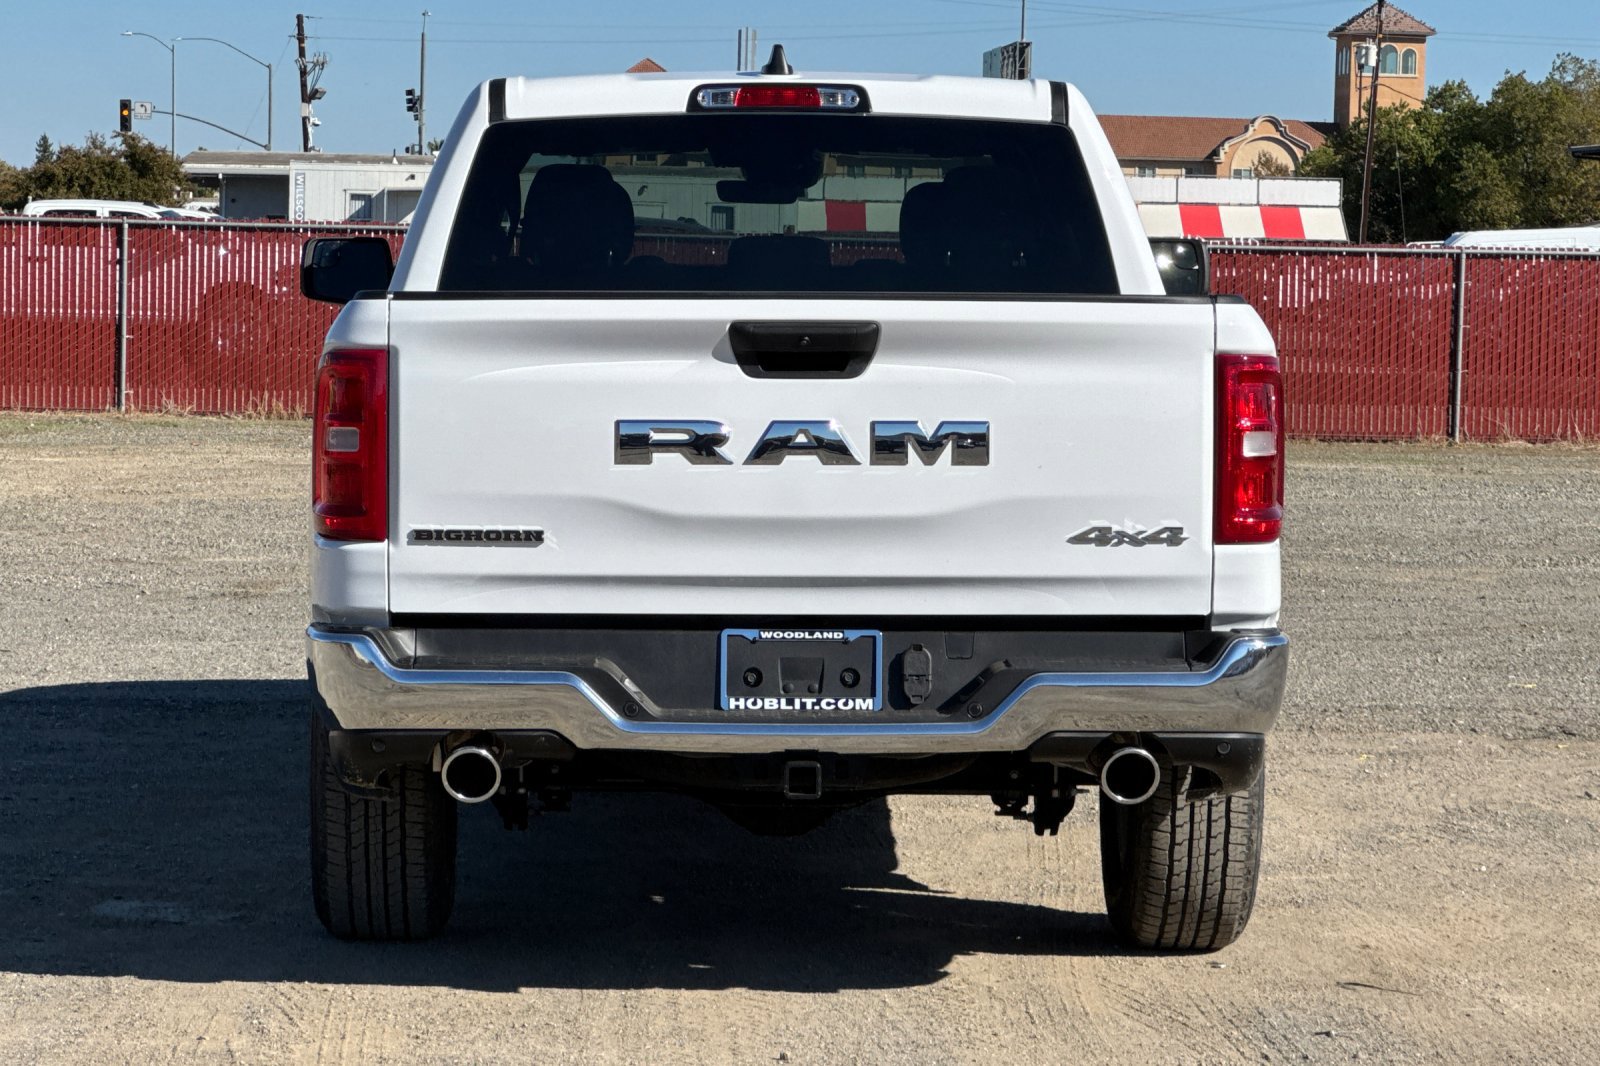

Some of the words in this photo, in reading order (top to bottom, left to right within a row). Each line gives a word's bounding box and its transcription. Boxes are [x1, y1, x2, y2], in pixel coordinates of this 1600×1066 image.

[614, 420, 990, 466] RAM
[412, 528, 545, 543] BIGHORN
[760, 631, 844, 640] WOODLAND
[728, 697, 874, 711] HOBLIT.COM
